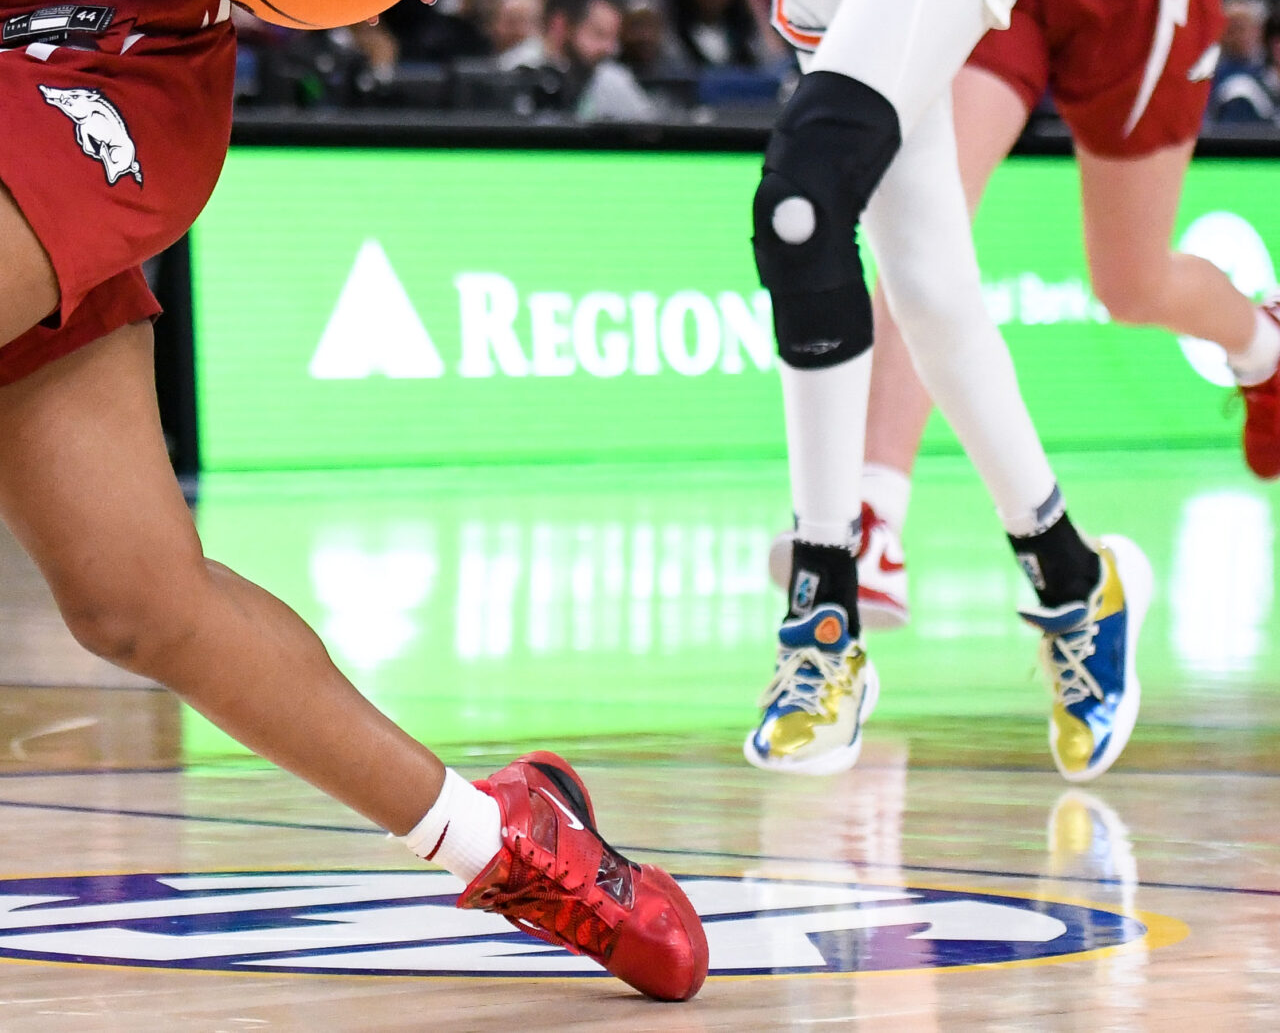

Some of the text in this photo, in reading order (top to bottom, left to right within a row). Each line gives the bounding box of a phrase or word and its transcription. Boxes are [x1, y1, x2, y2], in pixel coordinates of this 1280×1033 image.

[76, 9, 98, 23] 44
[6, 21, 28, 32] TEAM
[454, 270, 779, 378] REGION
